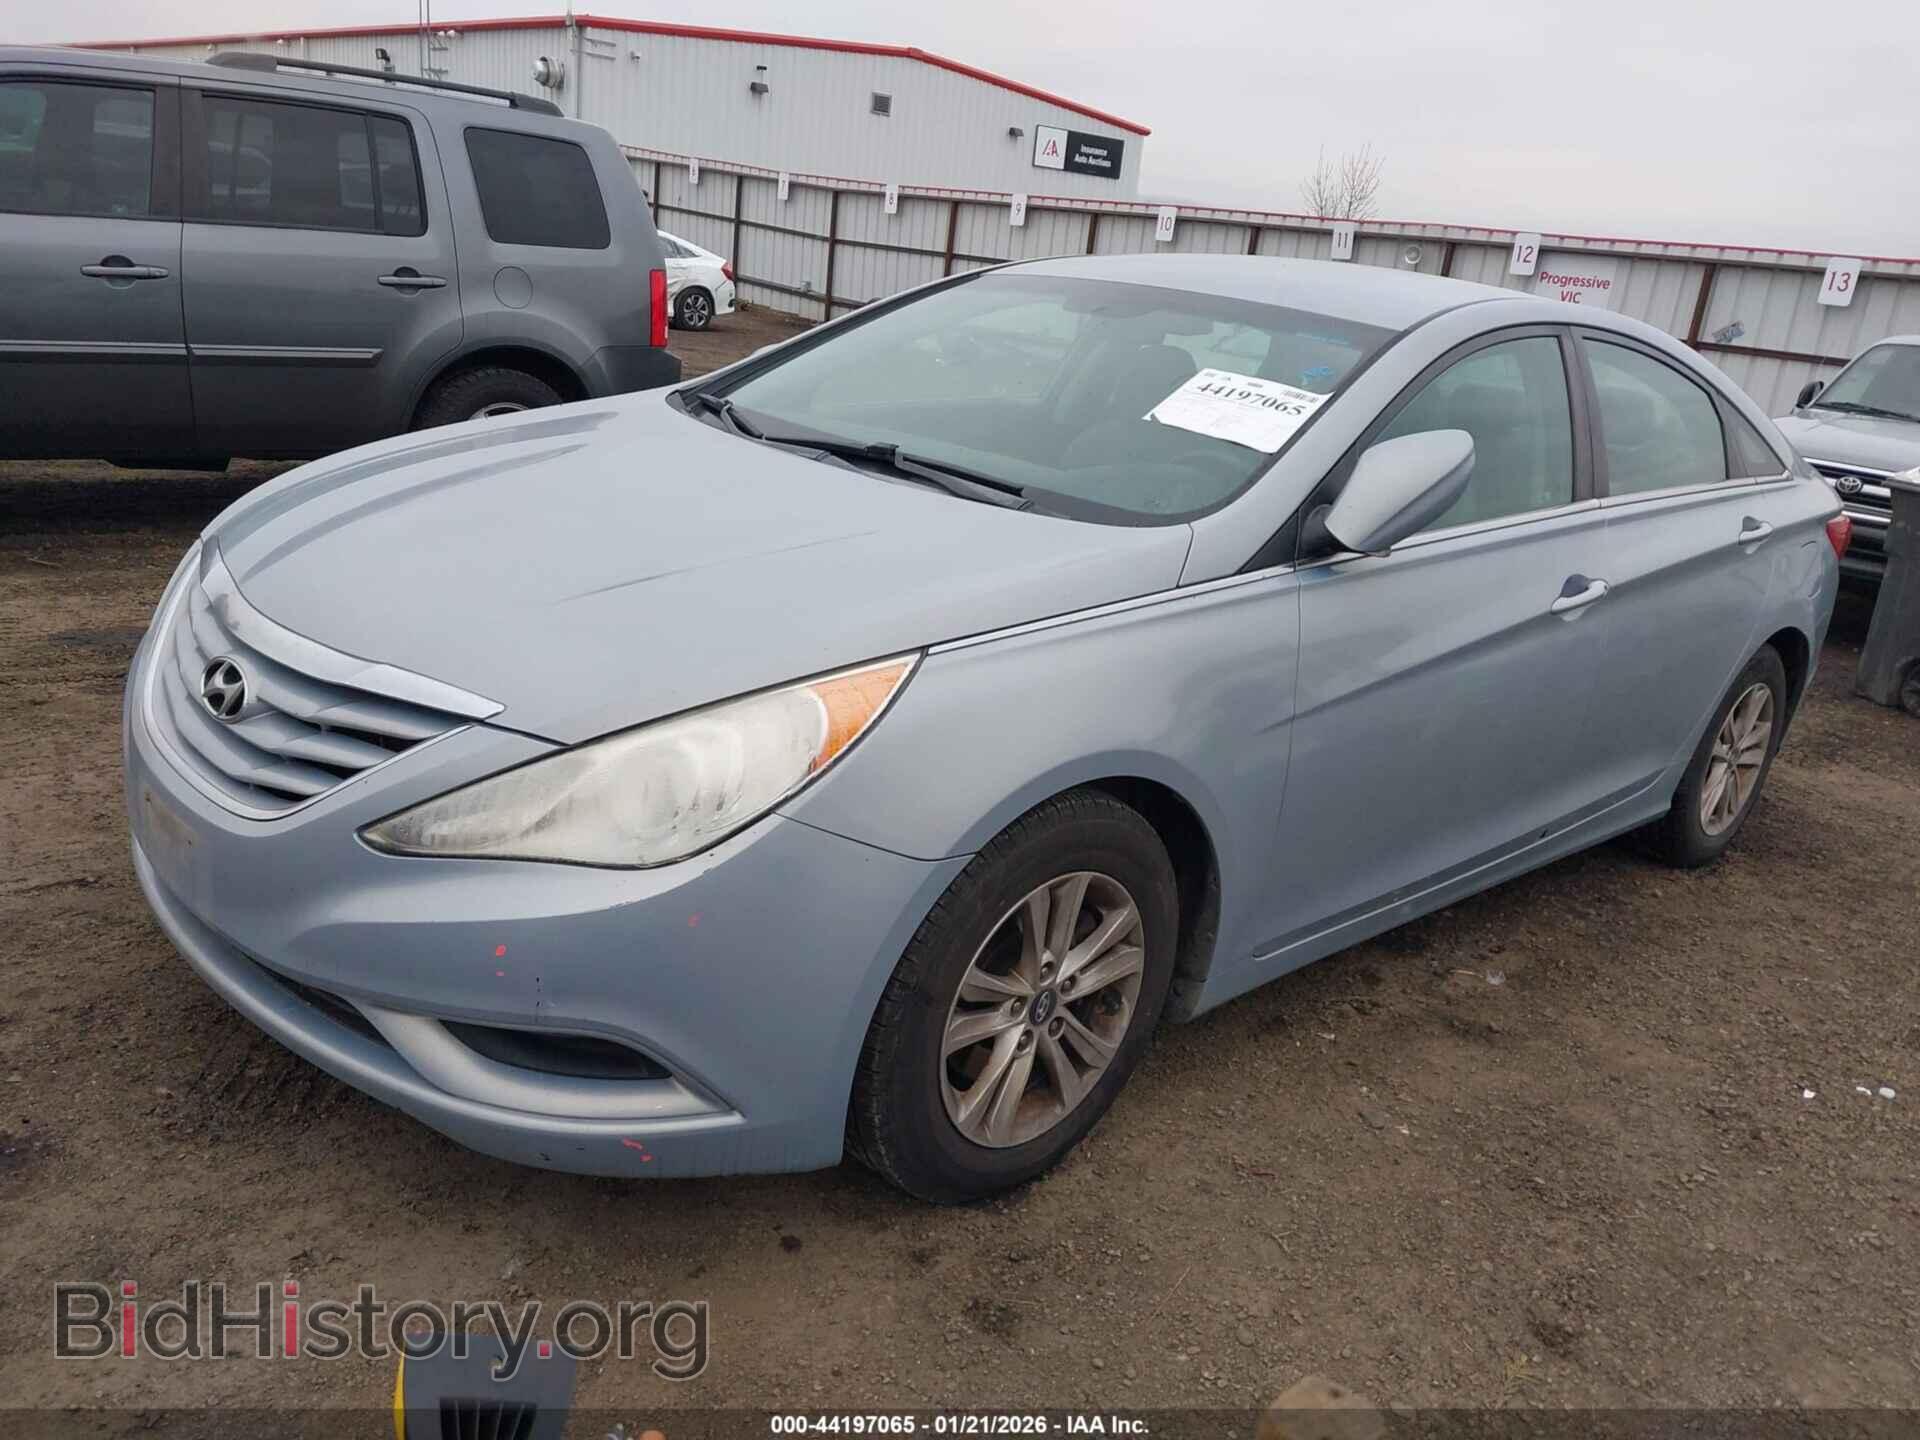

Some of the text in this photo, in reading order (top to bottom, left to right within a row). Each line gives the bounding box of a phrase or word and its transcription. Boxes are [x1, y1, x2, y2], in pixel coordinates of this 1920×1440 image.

[1080, 143, 1108, 157] Insurance
[1074, 153, 1112, 168] Auto Auctions
[1160, 215, 1173, 231] 10
[1337, 231, 1348, 249] 11
[1516, 244, 1535, 264] 12
[1539, 271, 1611, 290] Progressive
[1827, 270, 1852, 293] 13
[1560, 289, 1582, 304] VIC
[1196, 382, 1307, 417] 44197065
